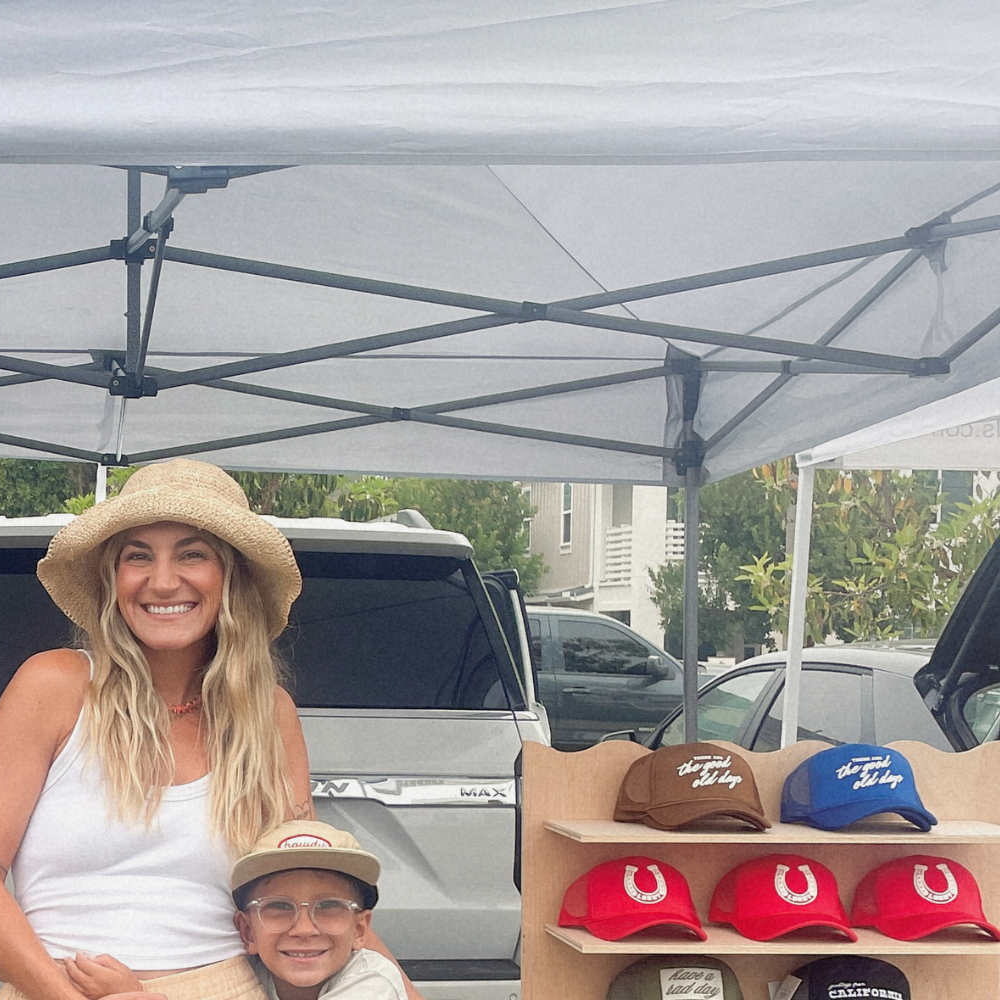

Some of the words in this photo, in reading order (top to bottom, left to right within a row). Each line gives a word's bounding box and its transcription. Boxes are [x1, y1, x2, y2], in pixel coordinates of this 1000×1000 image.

[677, 760, 703, 776] the
[700, 755, 732, 776] good
[835, 762, 863, 779] the
[860, 755, 892, 778] good
[692, 771, 719, 788] old
[852, 771, 879, 790] old
[460, 787, 507, 798] MAX
[668, 969, 704, 981] have
[705, 972, 716, 981] a
[666, 982, 697, 995] rad
[694, 983, 721, 999] day
